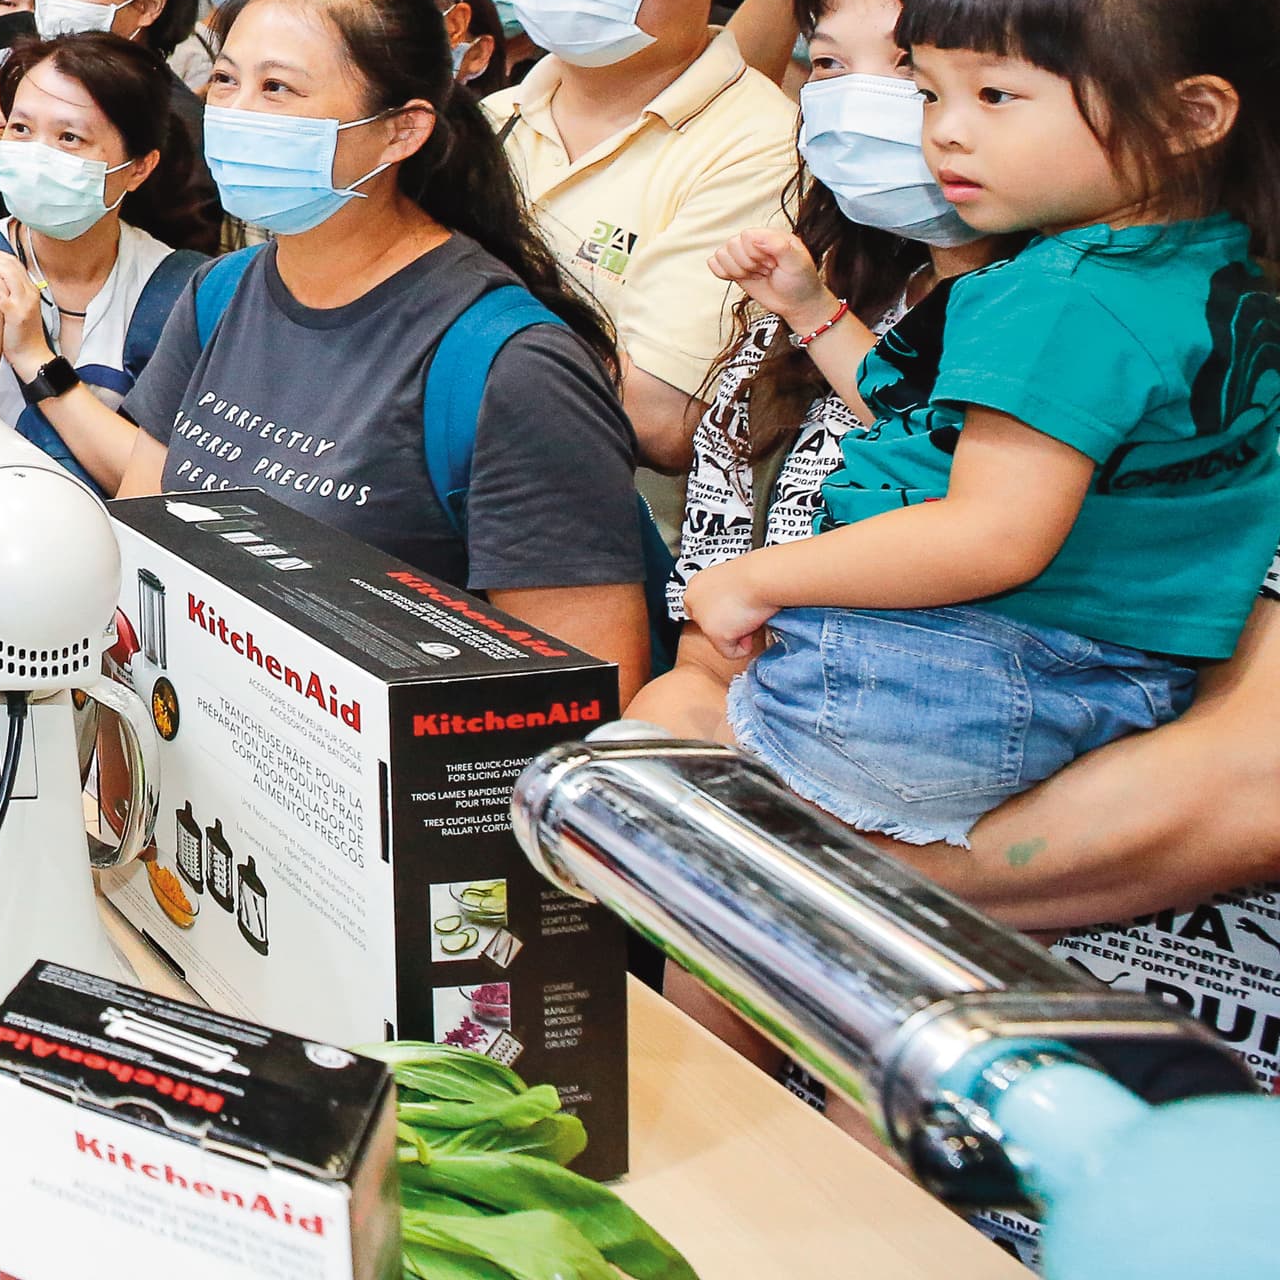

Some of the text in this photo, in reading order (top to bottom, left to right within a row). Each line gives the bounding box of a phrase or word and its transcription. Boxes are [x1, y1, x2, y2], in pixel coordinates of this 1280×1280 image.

[197, 391, 336, 458] PURRFECTLY
[252, 457, 372, 506] PRECIOUS
[385, 571, 569, 658] KitchenAid
[187, 591, 362, 734] KitchenAid
[412, 699, 601, 737] KitchenAid
[196, 695, 364, 832] PRÉPARATION DE PRODUITS FRAIS
[219, 696, 364, 814] TRANCHEUSE/RÂPE POUR LA
[446, 762, 473, 772] THREE
[447, 768, 521, 782] FOR SLICING AND
[231, 738, 346, 837] CORTADOR/RALLADOR
[347, 828, 365, 851] DE
[411, 791, 437, 802] TROIS
[438, 789, 467, 800] LAMES
[455, 799, 480, 809] POUR
[252, 773, 312, 828] ALIMENTOS
[314, 820, 365, 870] FRESCOS
[423, 813, 506, 828] TRES CUCHILLAS DE
[441, 826, 473, 837] RALLAR
[474, 825, 482, 834] Y
[1107, 937, 1131, 952] BE
[1134, 944, 1236, 982] DIFFERENT
[1130, 957, 1189, 981] FORTY
[1194, 976, 1251, 1001] EIGHT
[544, 1027, 583, 1040] RALLADO
[73, 1128, 326, 1238] KitchenAid
